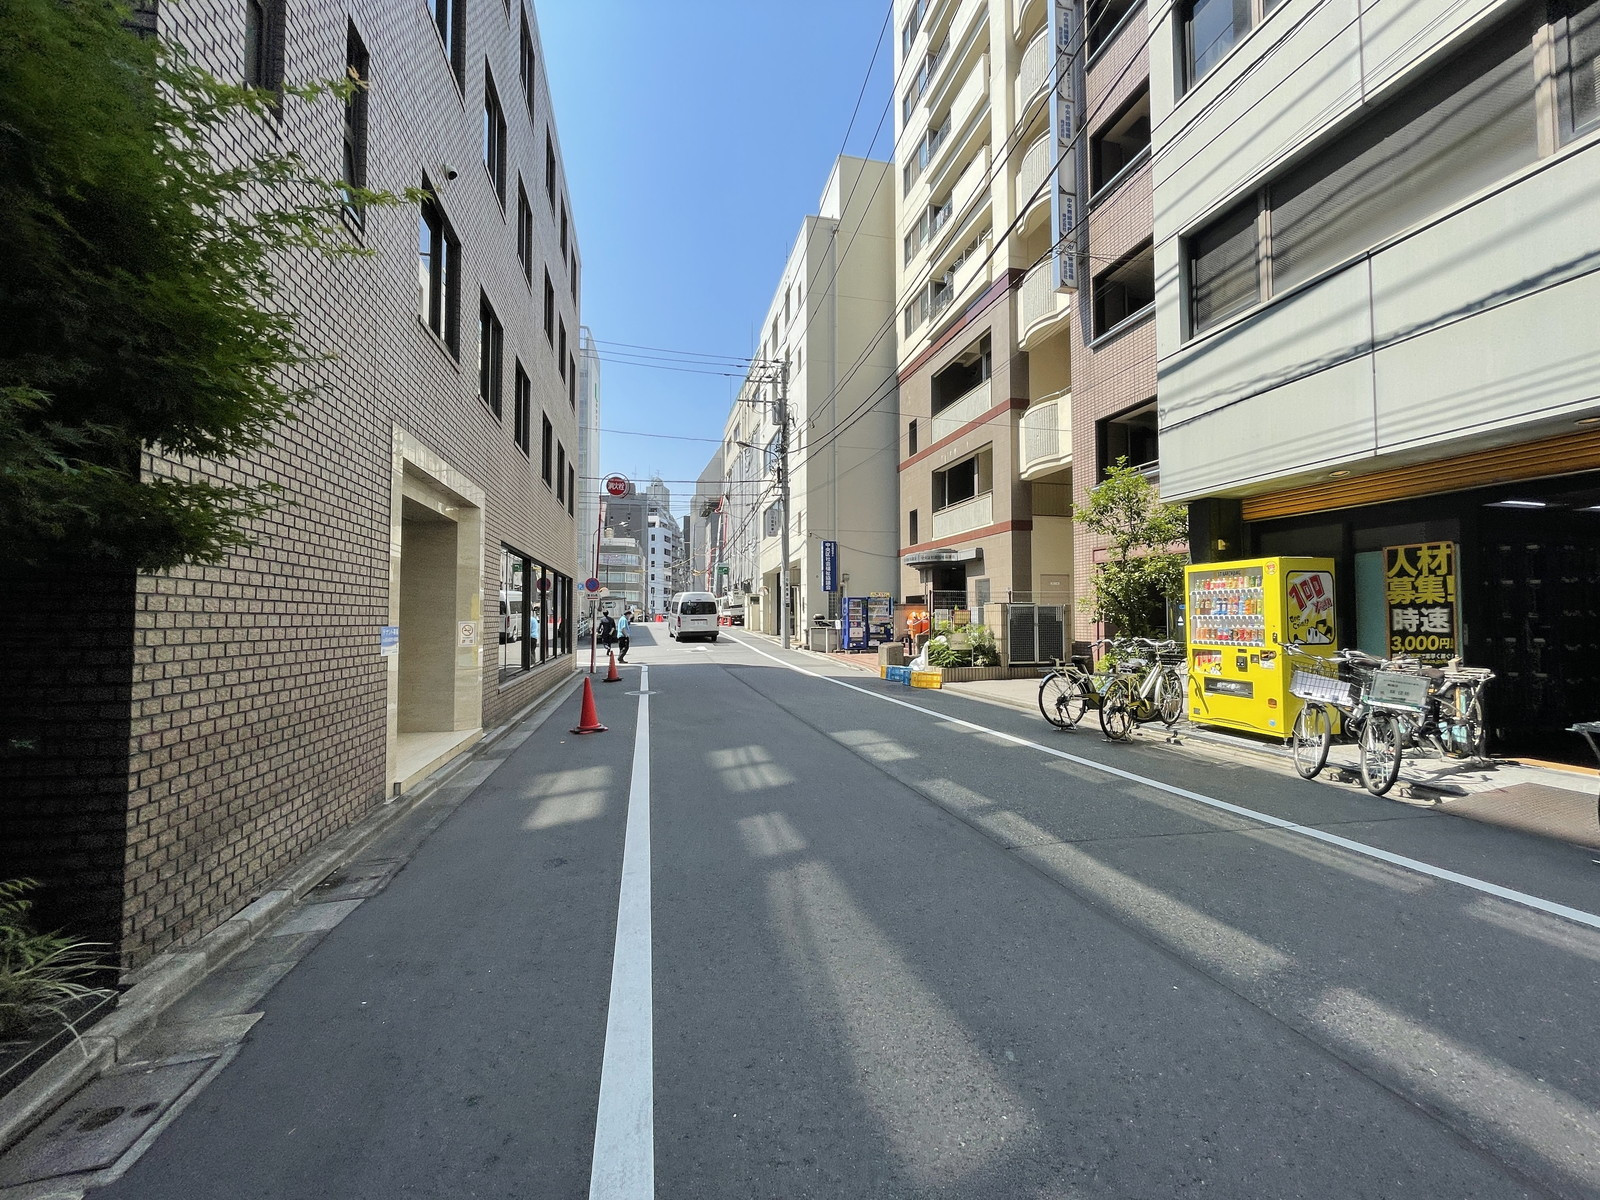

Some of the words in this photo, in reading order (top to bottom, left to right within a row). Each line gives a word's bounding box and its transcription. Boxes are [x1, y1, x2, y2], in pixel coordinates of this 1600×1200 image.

[608, 481, 625, 491] 消火栓
[1387, 544, 1451, 578] 人材
[1288, 574, 1325, 612] 100
[1386, 575, 1456, 605] 募集!
[1391, 607, 1451, 633] 時速
